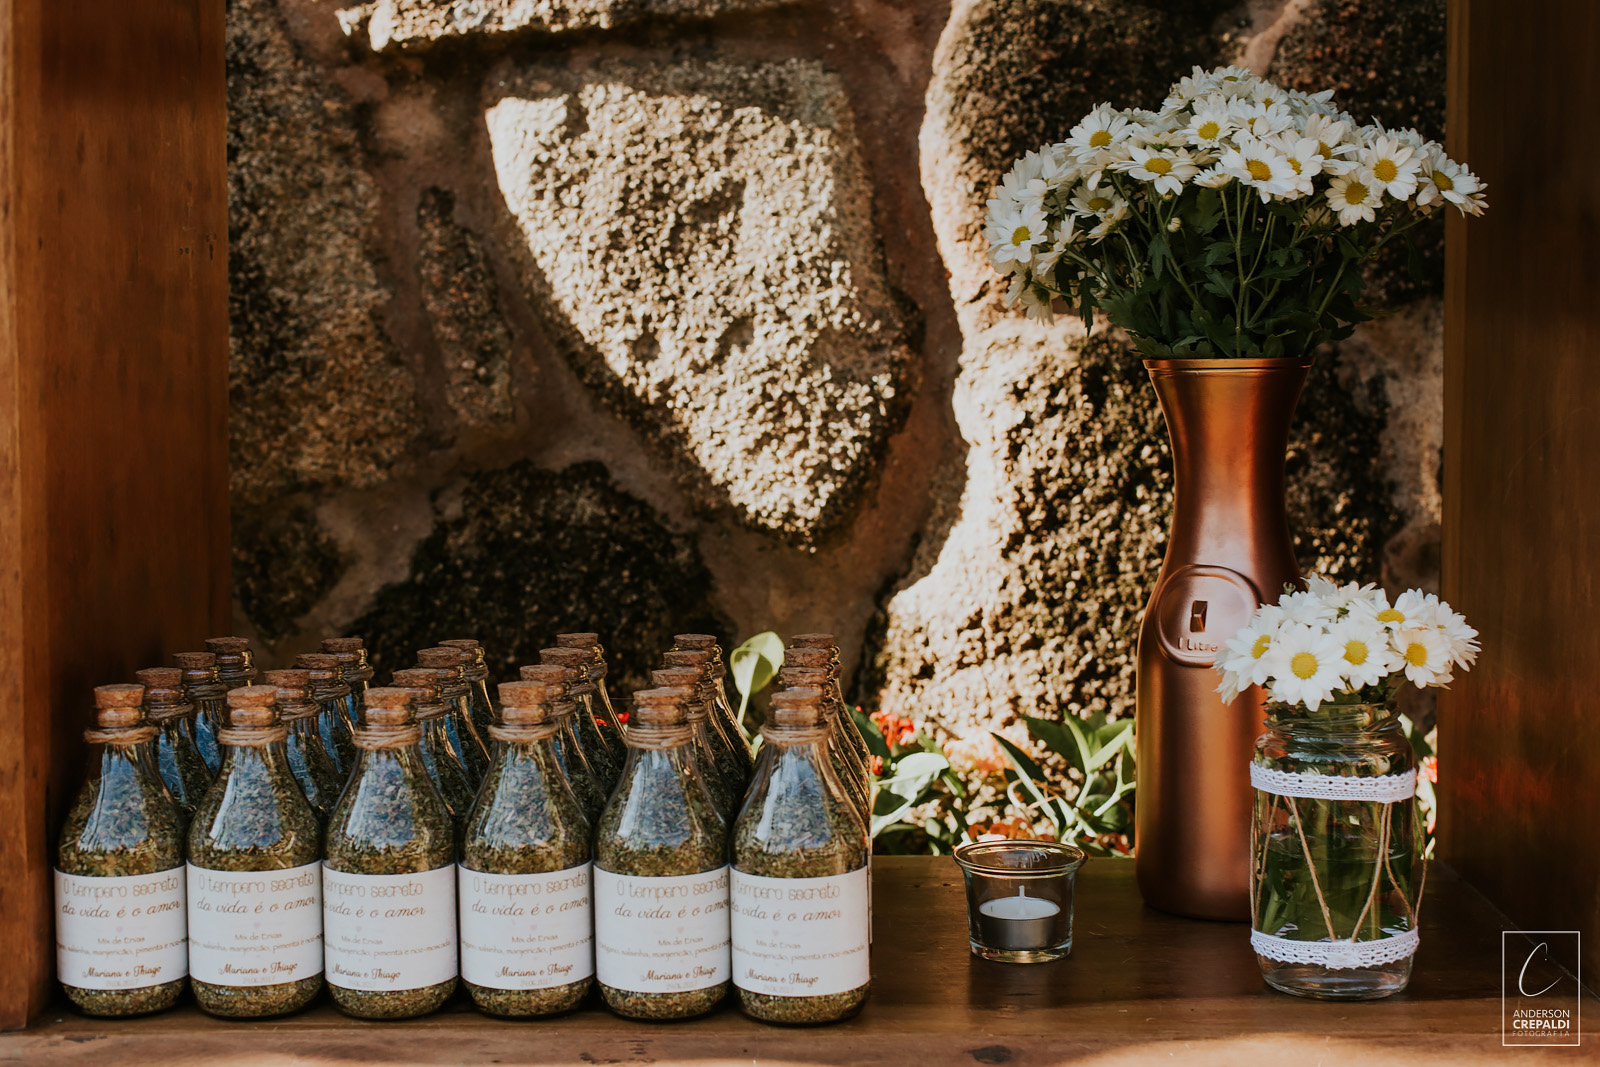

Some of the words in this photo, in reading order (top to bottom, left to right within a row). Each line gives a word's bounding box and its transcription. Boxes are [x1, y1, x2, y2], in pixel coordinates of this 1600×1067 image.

[72, 880, 127, 902] tempero
[133, 875, 178, 896] secreto
[208, 876, 265, 898] tempero
[271, 871, 314, 892] secreto
[371, 881, 423, 898] secreto
[484, 878, 541, 900] tempero
[547, 872, 587, 894] secreto
[629, 880, 688, 903] tempero
[736, 879, 783, 902] tempero
[788, 883, 840, 901] secreto
[62, 900, 75, 915] da
[80, 904, 110, 918] vida
[116, 906, 126, 918] é
[132, 908, 141, 917] o
[147, 900, 180, 914] amor
[197, 897, 211, 911] da
[216, 900, 247, 913] vida
[254, 903, 263, 913] é
[270, 904, 278, 912] o
[284, 896, 316, 910] amor
[329, 902, 351, 915] vida
[356, 906, 365, 917] é
[370, 909, 379, 918] o
[385, 906, 426, 918] amor
[472, 899, 487, 913] da
[492, 902, 525, 916] vida
[531, 904, 540, 916] é
[546, 905, 554, 914] o
[560, 897, 589, 912] amor
[615, 902, 632, 918] da
[638, 904, 672, 919] vida
[678, 906, 687, 918] é
[692, 907, 700, 916] o
[742, 905, 767, 919] vida
[773, 910, 780, 921] é
[788, 912, 797, 921] o
[803, 910, 841, 921] amor
[83, 967, 122, 978] Mariana
[134, 965, 161, 977] Thiago
[218, 963, 259, 975] Mariana
[271, 962, 298, 974] Thiago
[332, 963, 361, 978] Mariana
[371, 968, 400, 983] Thiago
[496, 966, 537, 977] Mariana
[547, 963, 574, 976] Thiago
[640, 970, 682, 981] Mariana
[693, 966, 717, 979] Thiago
[745, 968, 777, 983] Mariana
[789, 973, 819, 987] Thiago
